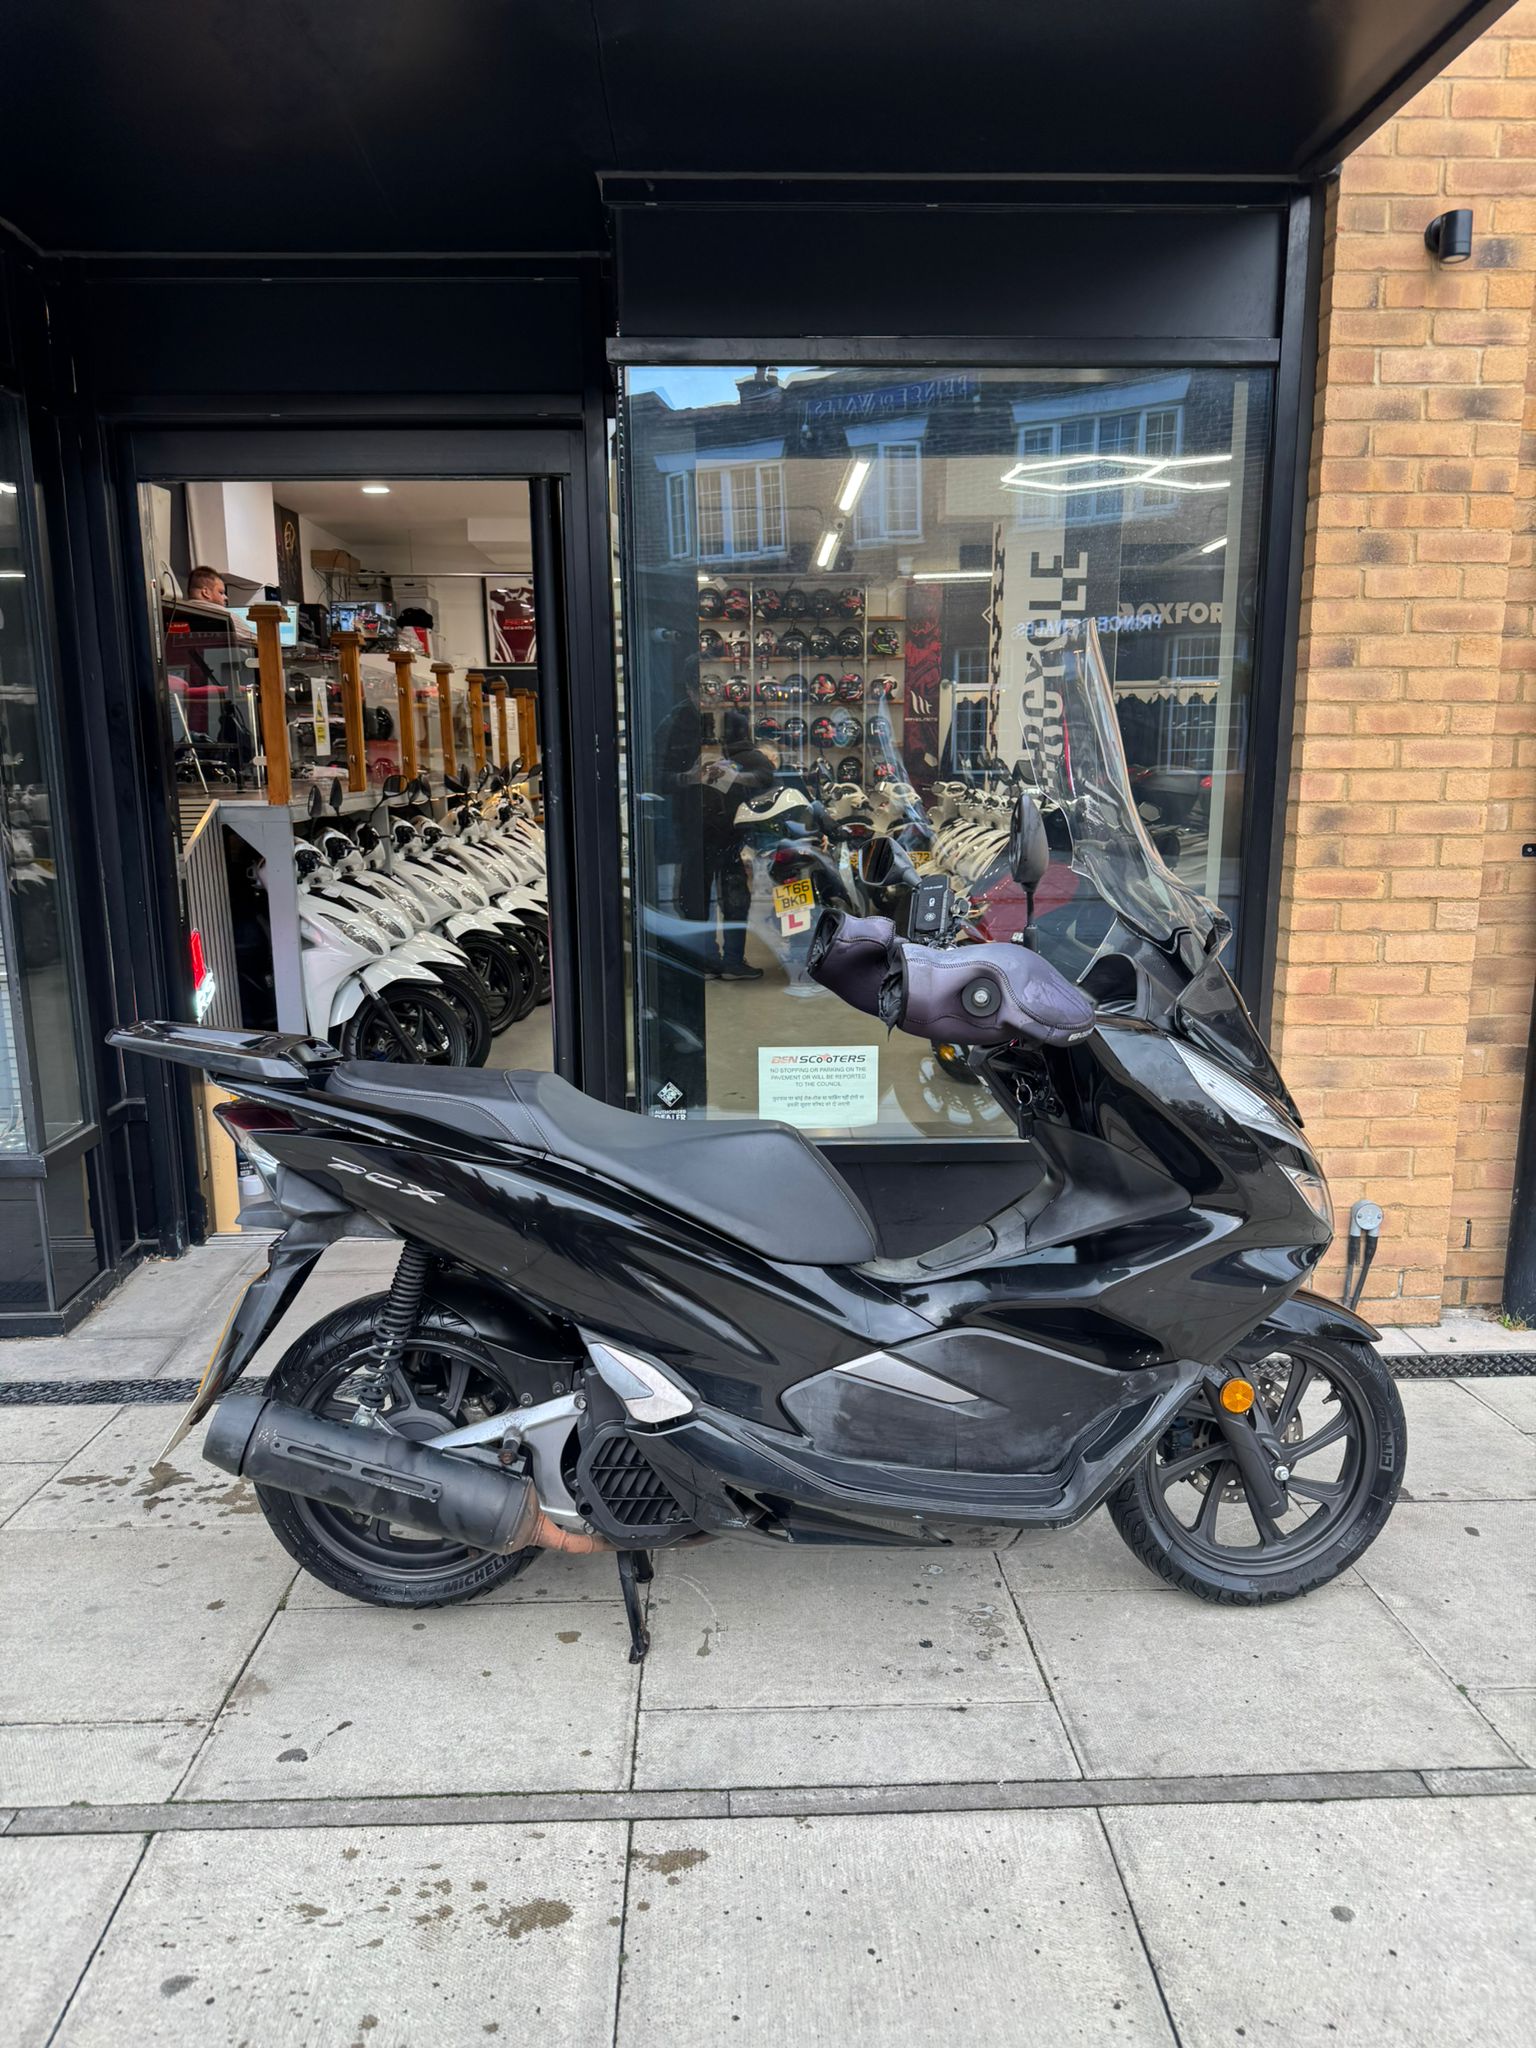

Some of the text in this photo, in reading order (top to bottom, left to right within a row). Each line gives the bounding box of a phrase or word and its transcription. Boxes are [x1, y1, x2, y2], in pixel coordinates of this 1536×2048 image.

[1137, 602, 1223, 624] OXFOR
[775, 880, 810, 899] LT66
[782, 893, 807, 909] BKD
[788, 914, 804, 929] L
[771, 1054, 867, 1064] BEN SCOOTERS
[327, 1157, 446, 1204] PCX
[443, 1552, 516, 1593] MICHELI
